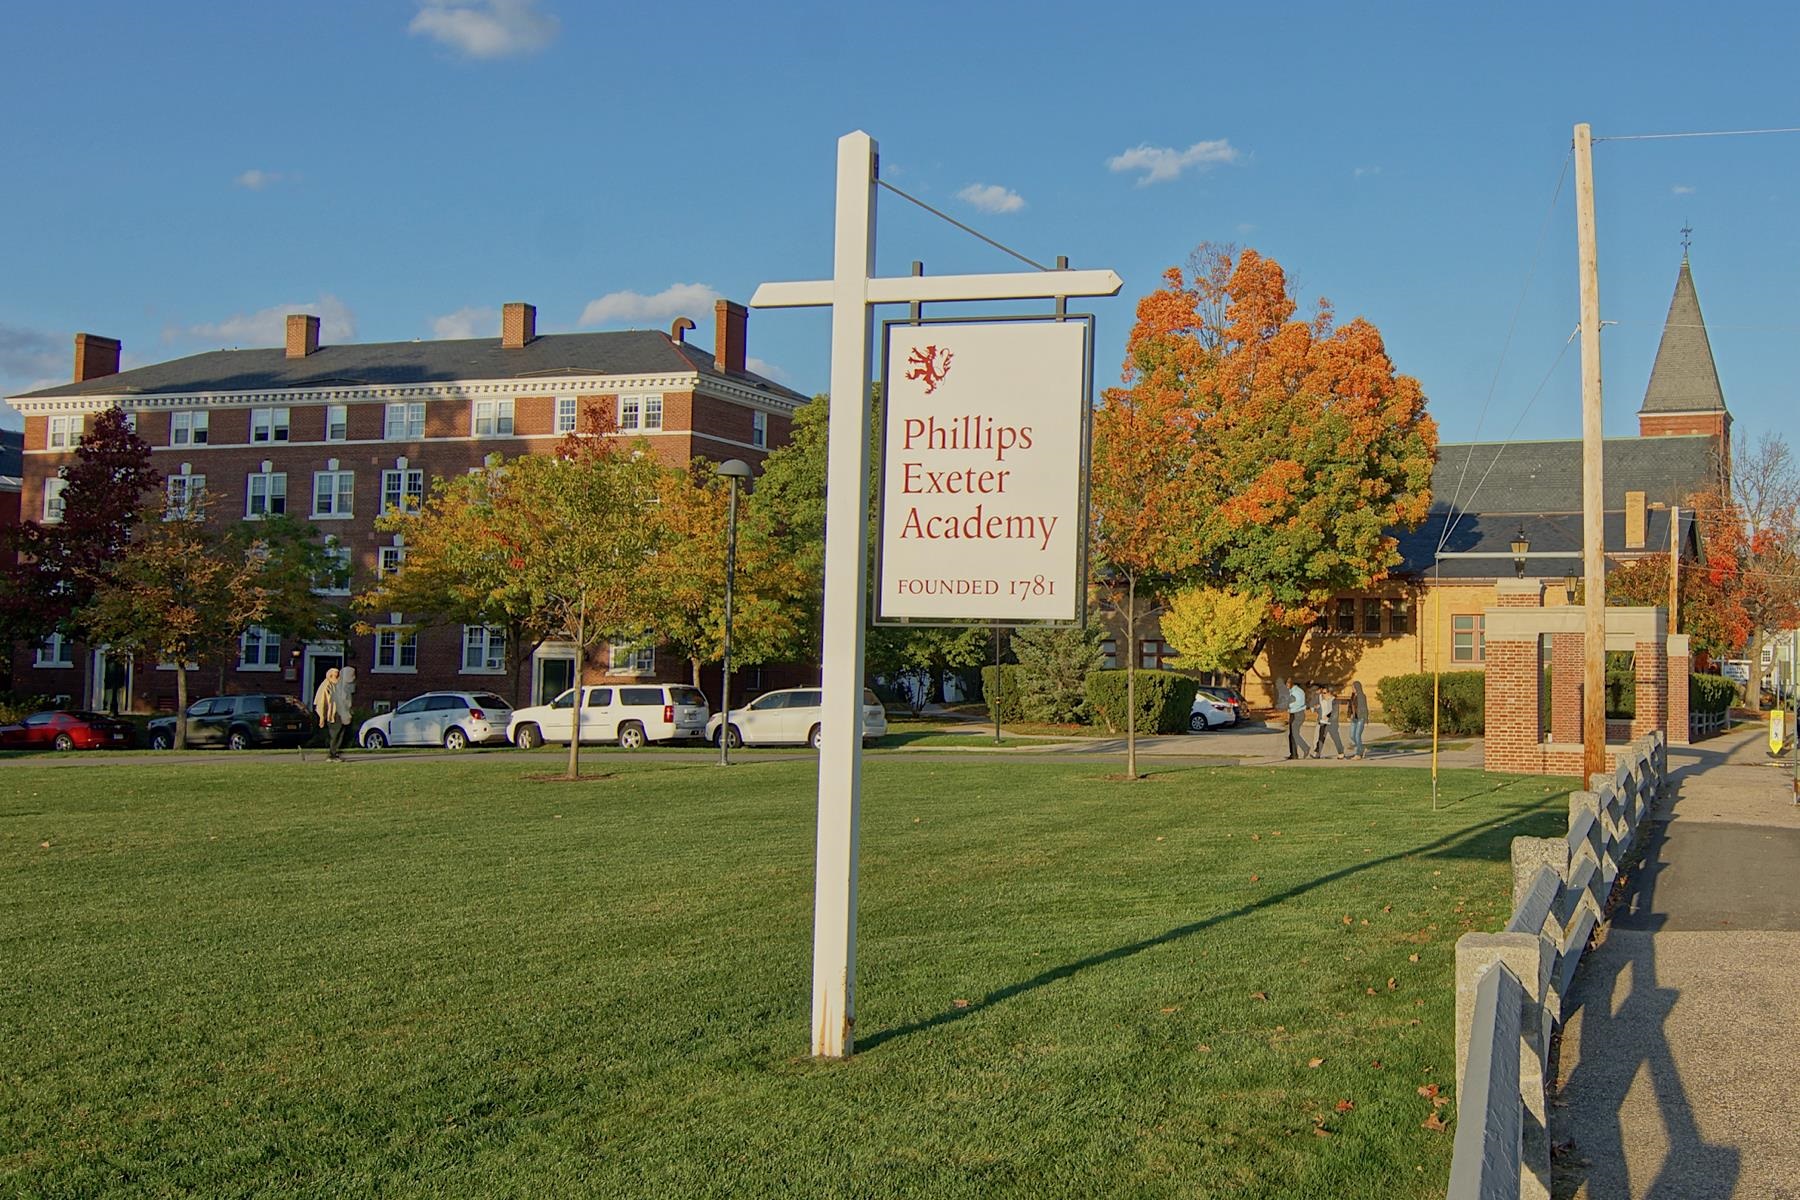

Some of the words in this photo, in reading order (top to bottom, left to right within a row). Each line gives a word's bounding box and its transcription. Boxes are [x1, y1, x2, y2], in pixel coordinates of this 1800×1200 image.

[902, 415, 1033, 462] Phillips
[902, 462, 1011, 494] Exeter
[899, 504, 1059, 551] Academy
[898, 579, 999, 595] FOUNDED
[1010, 575, 1055, 601] 1781
